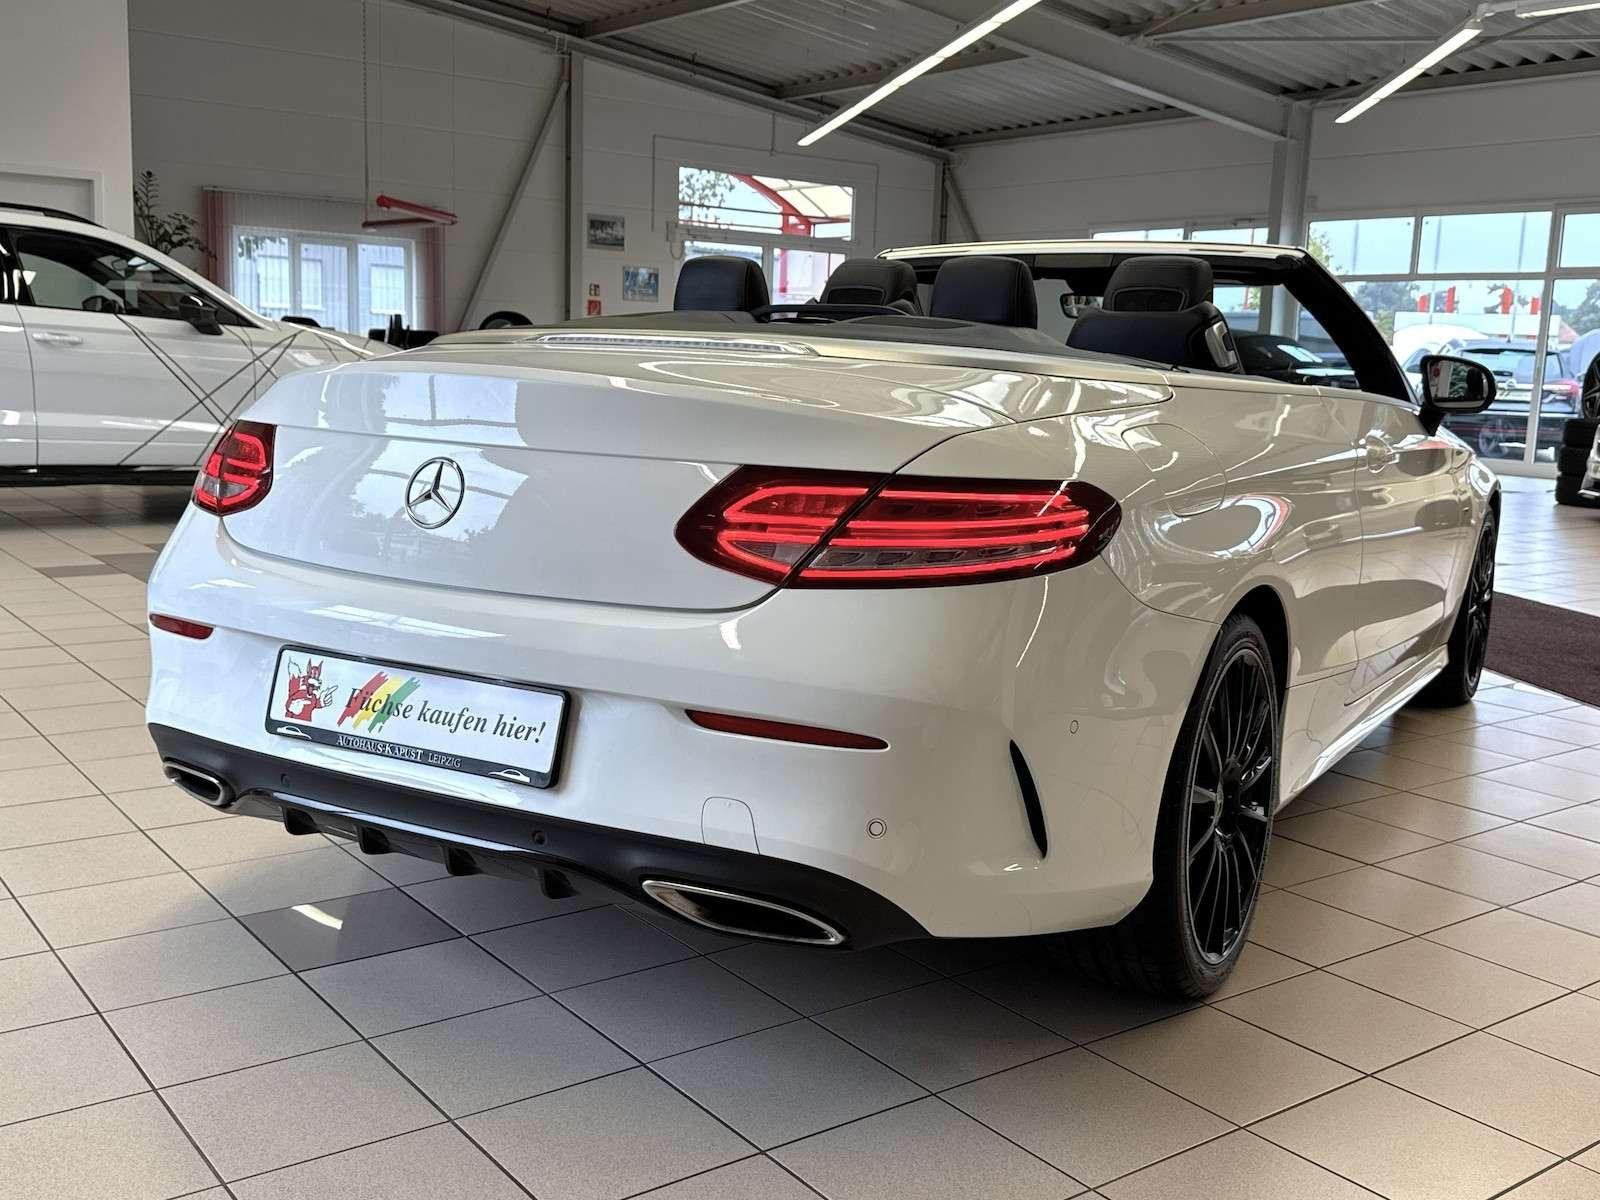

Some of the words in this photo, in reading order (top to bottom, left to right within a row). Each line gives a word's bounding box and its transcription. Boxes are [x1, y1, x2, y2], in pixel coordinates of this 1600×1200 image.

[346, 688, 413, 719] Füchse
[417, 700, 488, 734] kaufen
[492, 713, 547, 744] hier!
[428, 752, 462, 768] LEIPZIG
